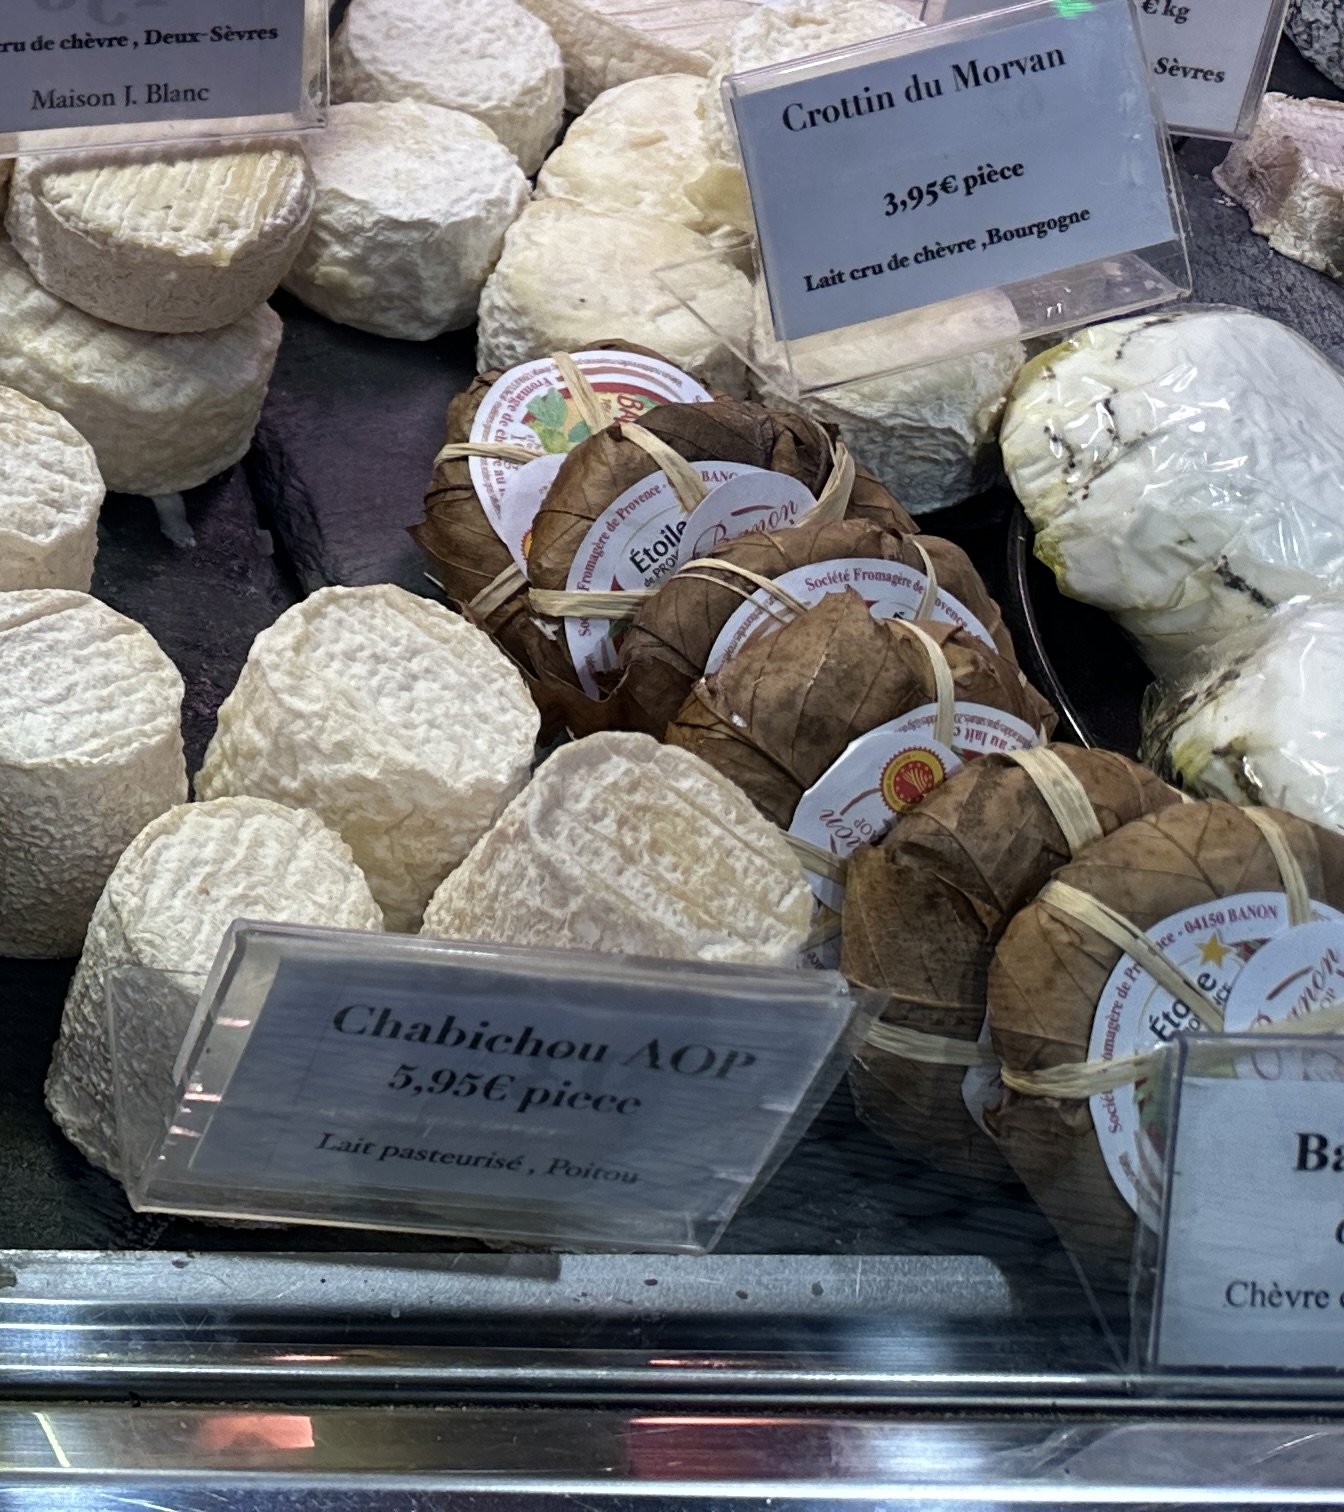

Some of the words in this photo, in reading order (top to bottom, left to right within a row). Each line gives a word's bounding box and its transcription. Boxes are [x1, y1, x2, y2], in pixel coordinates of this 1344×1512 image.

[782, 87, 896, 132] Crottin
[904, 72, 944, 105] du
[950, 45, 1067, 93] Morvan
[1154, 56, 1226, 85] Sèvres
[883, 174, 960, 218] 3,95€
[962, 159, 1025, 197] pièce
[628, 518, 688, 575] Étoile
[805, 566, 851, 592] Société
[853, 566, 914, 592] Fromagère
[1184, 911, 1226, 937] 04150
[1227, 903, 1278, 928] BANON
[332, 1002, 610, 1065] Chabichou
[620, 1035, 757, 1081] AOP
[387, 1062, 518, 1104] 5,95€
[315, 1131, 375, 1156] Lait
[379, 1140, 525, 1174] pasteurisé
[544, 1156, 640, 1186] Poitou
[1225, 1279, 1330, 1310] Chèvre
